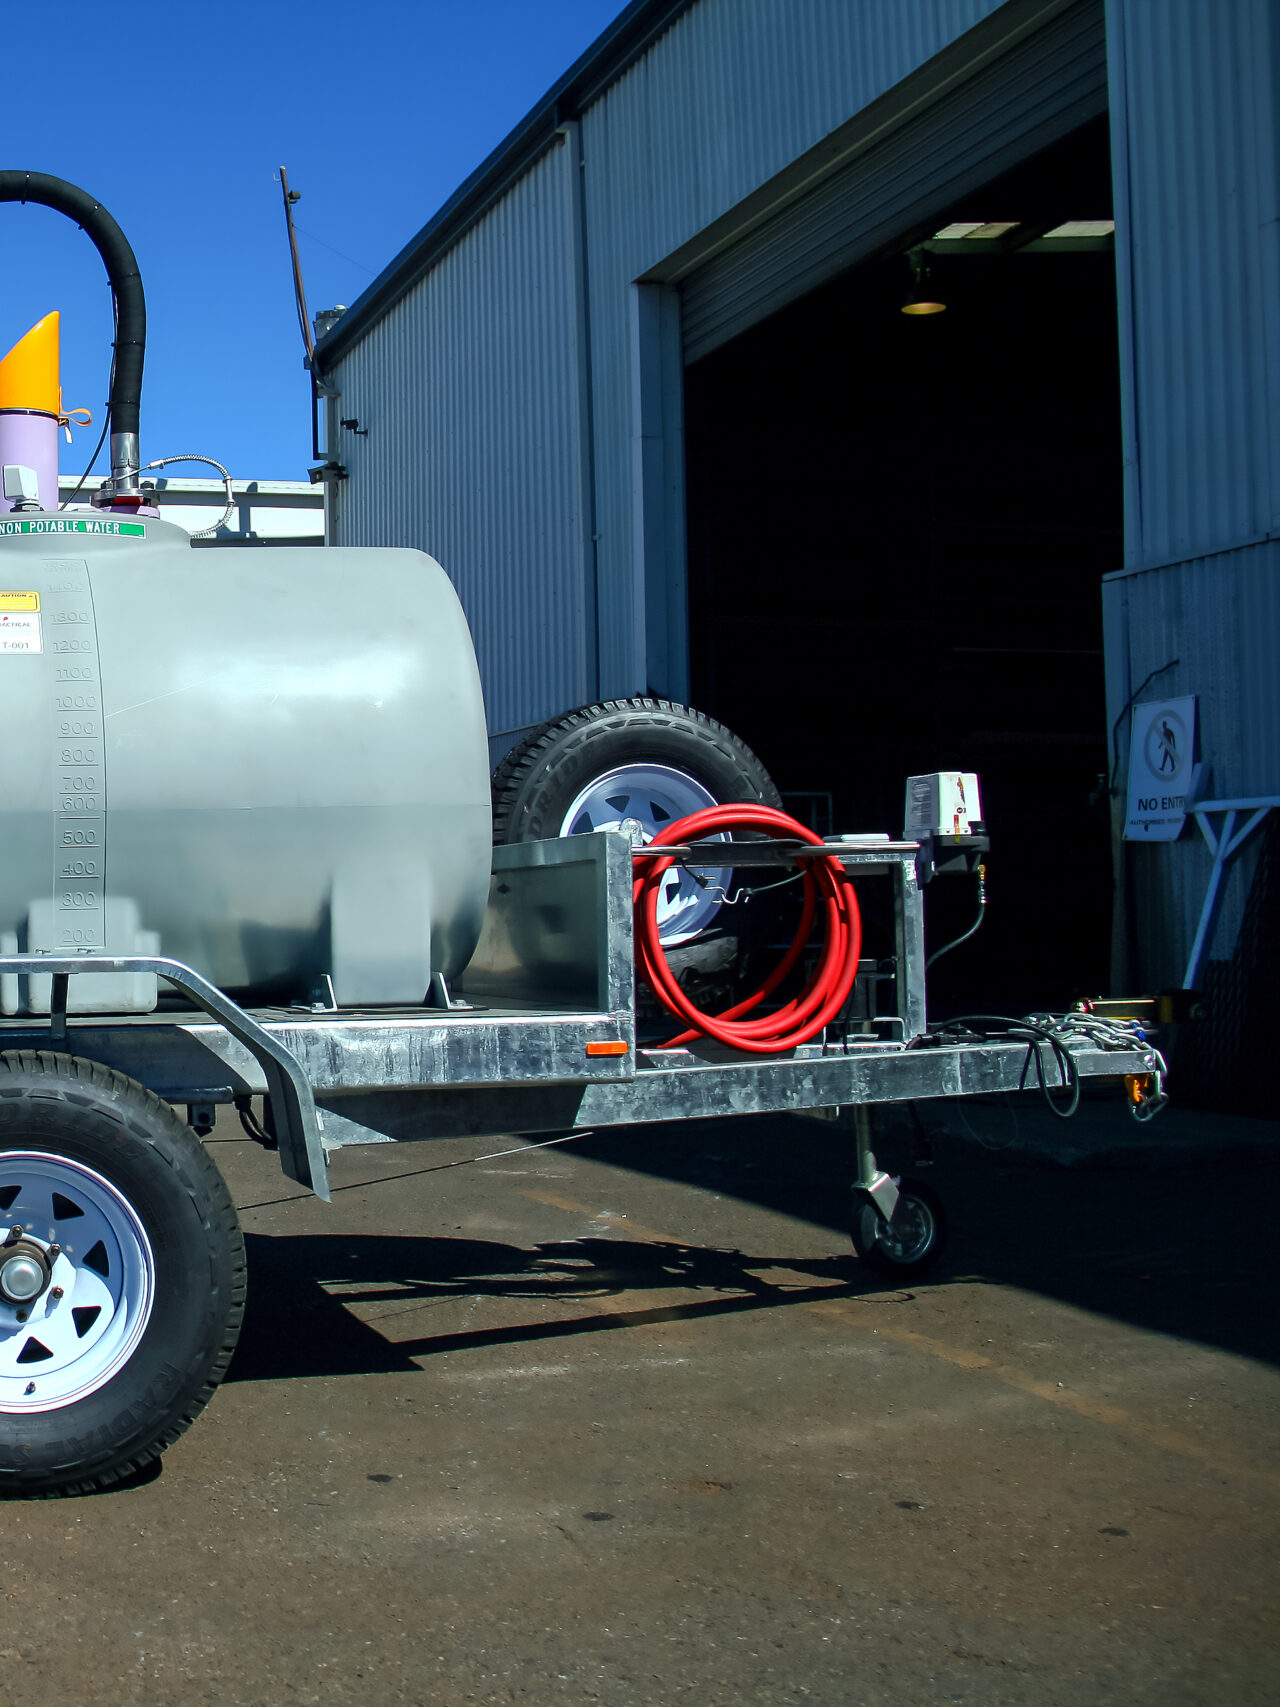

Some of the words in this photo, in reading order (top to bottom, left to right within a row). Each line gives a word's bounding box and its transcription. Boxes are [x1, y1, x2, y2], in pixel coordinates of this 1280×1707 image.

[28, 521, 79, 534] POTABLE
[85, 521, 121, 535] WATER
[2, 641, 30, 649] T-001
[52, 640, 91, 651] 1200
[55, 667, 92, 679] 1100
[55, 696, 96, 708] 1000
[60, 722, 95, 735] 900
[61, 749, 95, 763] 800
[62, 777, 95, 791] 700
[62, 797, 96, 811] 600
[1138, 797, 1158, 811] NO
[1161, 796, 1184, 810] ENTR
[62, 830, 96, 845] 500
[62, 860, 96, 875] 400
[62, 892, 96, 907] 300
[62, 929, 95, 943] 200
